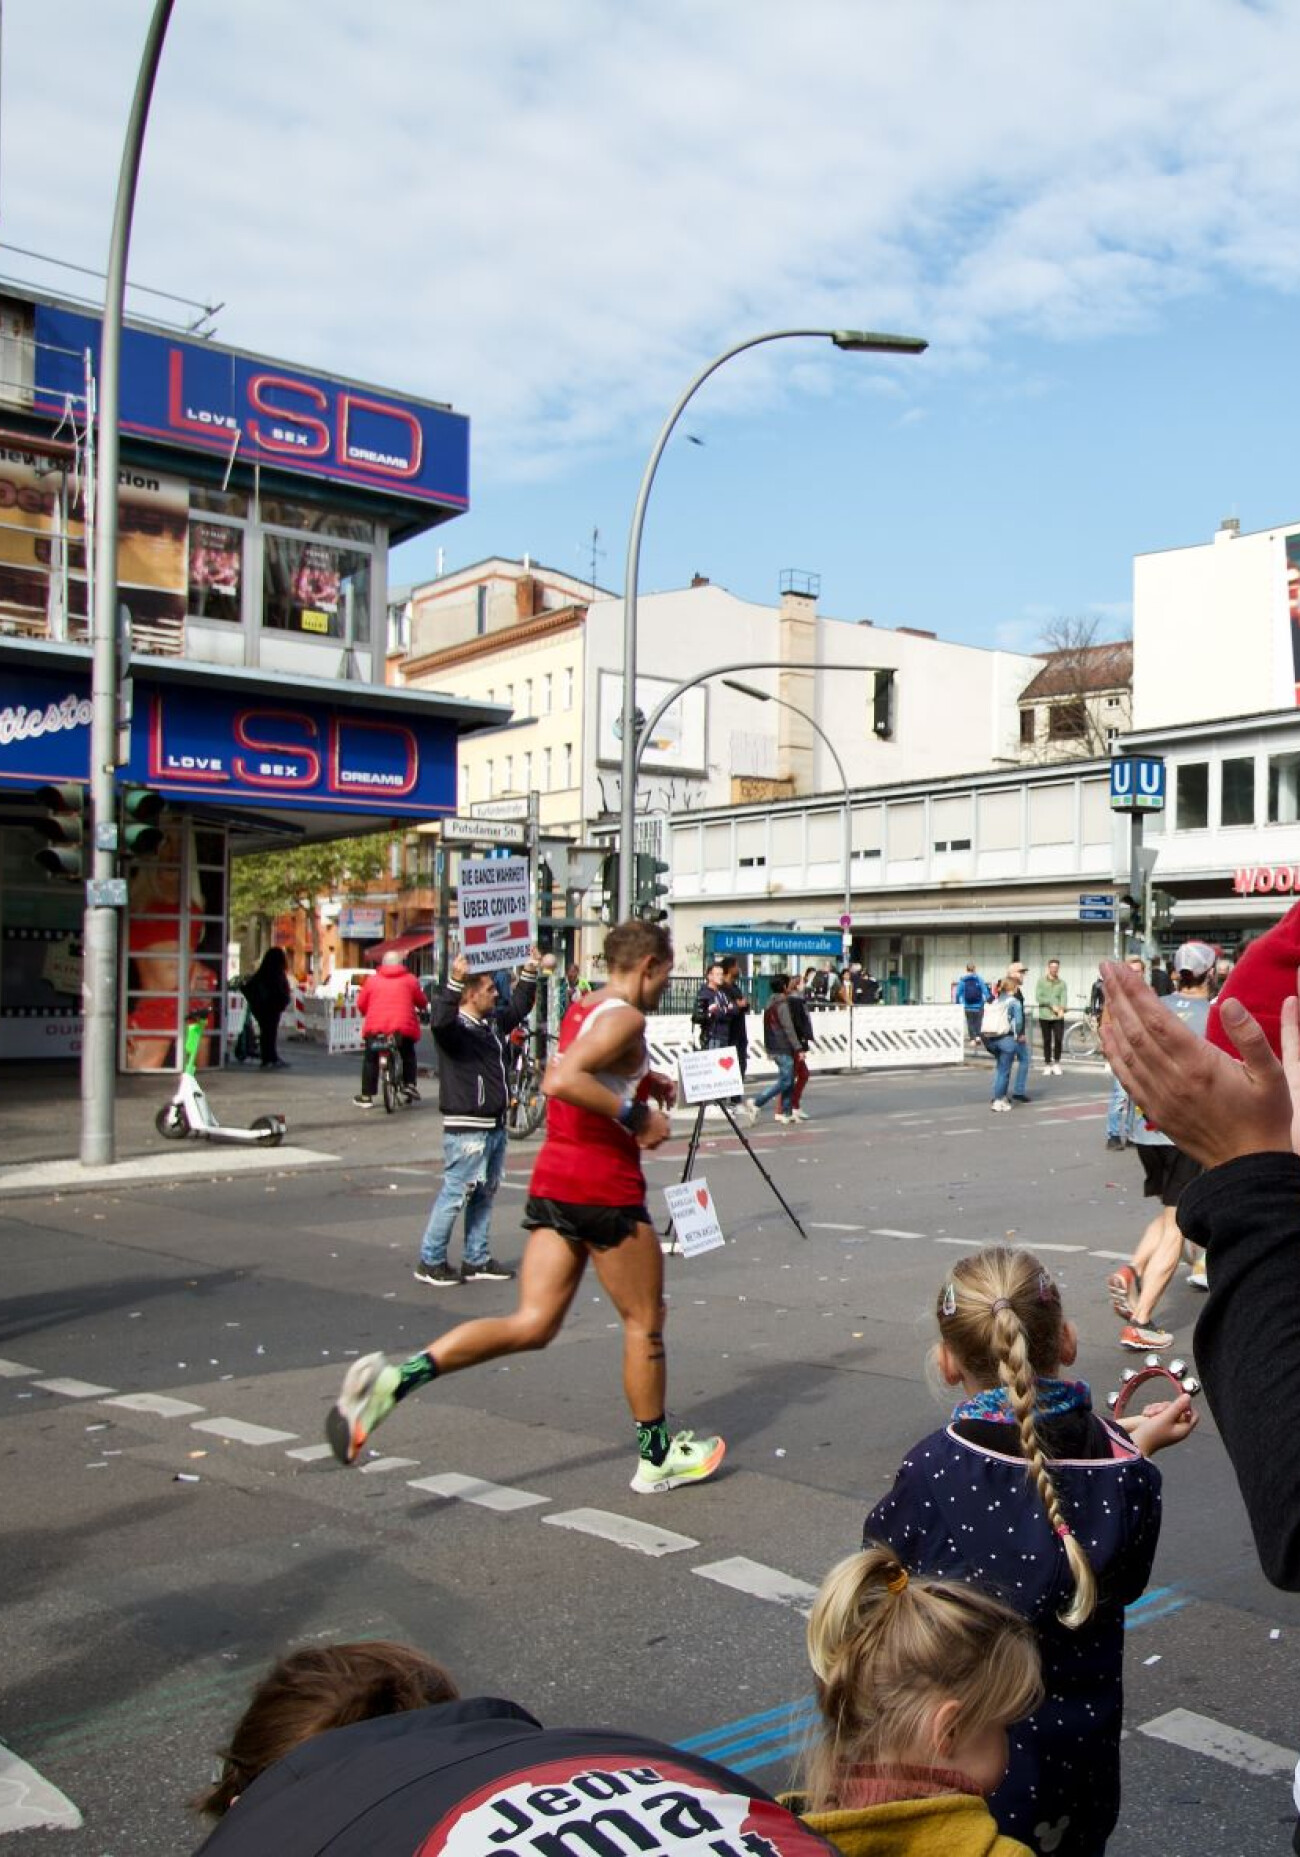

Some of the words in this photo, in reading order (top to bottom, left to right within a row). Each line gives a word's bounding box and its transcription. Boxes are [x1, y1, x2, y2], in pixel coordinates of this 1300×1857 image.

[168, 349, 422, 480] LSD
[186, 407, 237, 428] LOVE
[271, 427, 308, 446] SEX
[349, 446, 408, 469] DREAMS
[148, 693, 419, 797] LSD
[168, 755, 222, 771] LOVE
[259, 763, 298, 778] SEX
[341, 770, 404, 786] DREAMS
[1114, 764, 1130, 794] U
[1140, 764, 1160, 795] U
[462, 868, 473, 886] DIE
[474, 867, 495, 885] GANZE
[496, 865, 525, 883] WAHRHEIT
[463, 897, 489, 919] ÜBER
[490, 895, 526, 916] COVID-19
[725, 936, 753, 948] U-Bhf
[484, 1790, 725, 1857] ma
